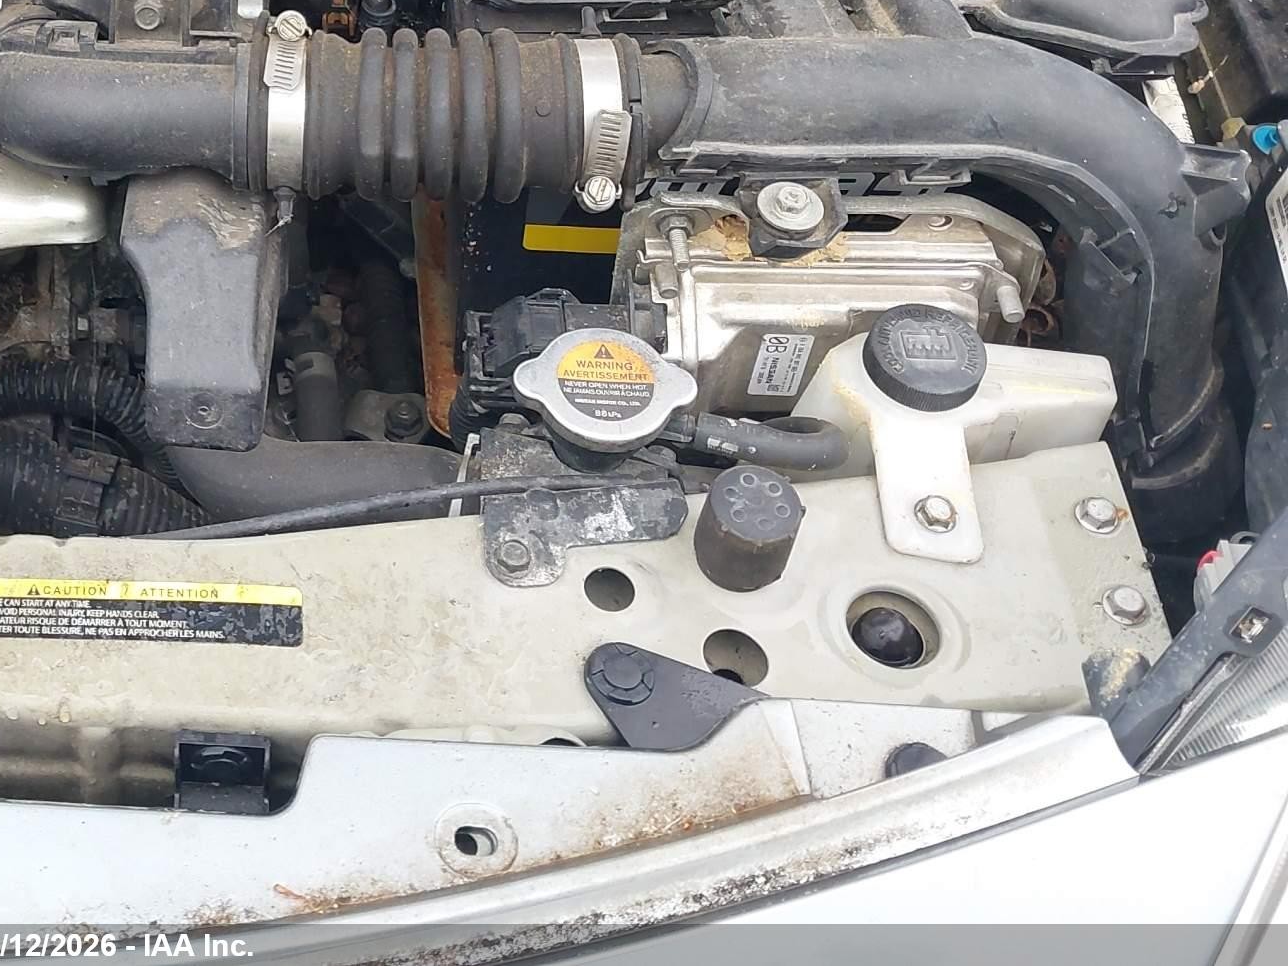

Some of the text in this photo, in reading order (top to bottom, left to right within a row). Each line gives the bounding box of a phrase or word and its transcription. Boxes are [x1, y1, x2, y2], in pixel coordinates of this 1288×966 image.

[576, 360, 633, 371] WARNING
[765, 356, 780, 384] NISSAN
[563, 369, 649, 382] AVERTISSEMENT
[565, 380, 587, 388] NEVER
[609, 382, 631, 390] WHEN
[43, 585, 107, 596] CAUTION
[140, 587, 219, 599] ATTENTION
[4, 598, 21, 607] CAN
[21, 599, 44, 607] START
[45, 599, 54, 608] AT
[55, 600, 70, 608] ANY
[18, 608, 57, 616] PERSONAL
[86, 609, 105, 617] KEEP
[106, 610, 132, 618] HANDS
[27, 617, 56, 626] RISQUE
[58, 617, 70, 626] DE
[71, 616, 116, 627] DÉMARRER
[124, 619, 148, 628] TOUT
[14, 625, 40, 634] TOUTE
[85, 627, 97, 635] NE
[98, 628, 114, 636] PAS
[115, 628, 127, 636] EN
[128, 629, 180, 638] APPROCHER
[180, 630, 195, 638] LES
